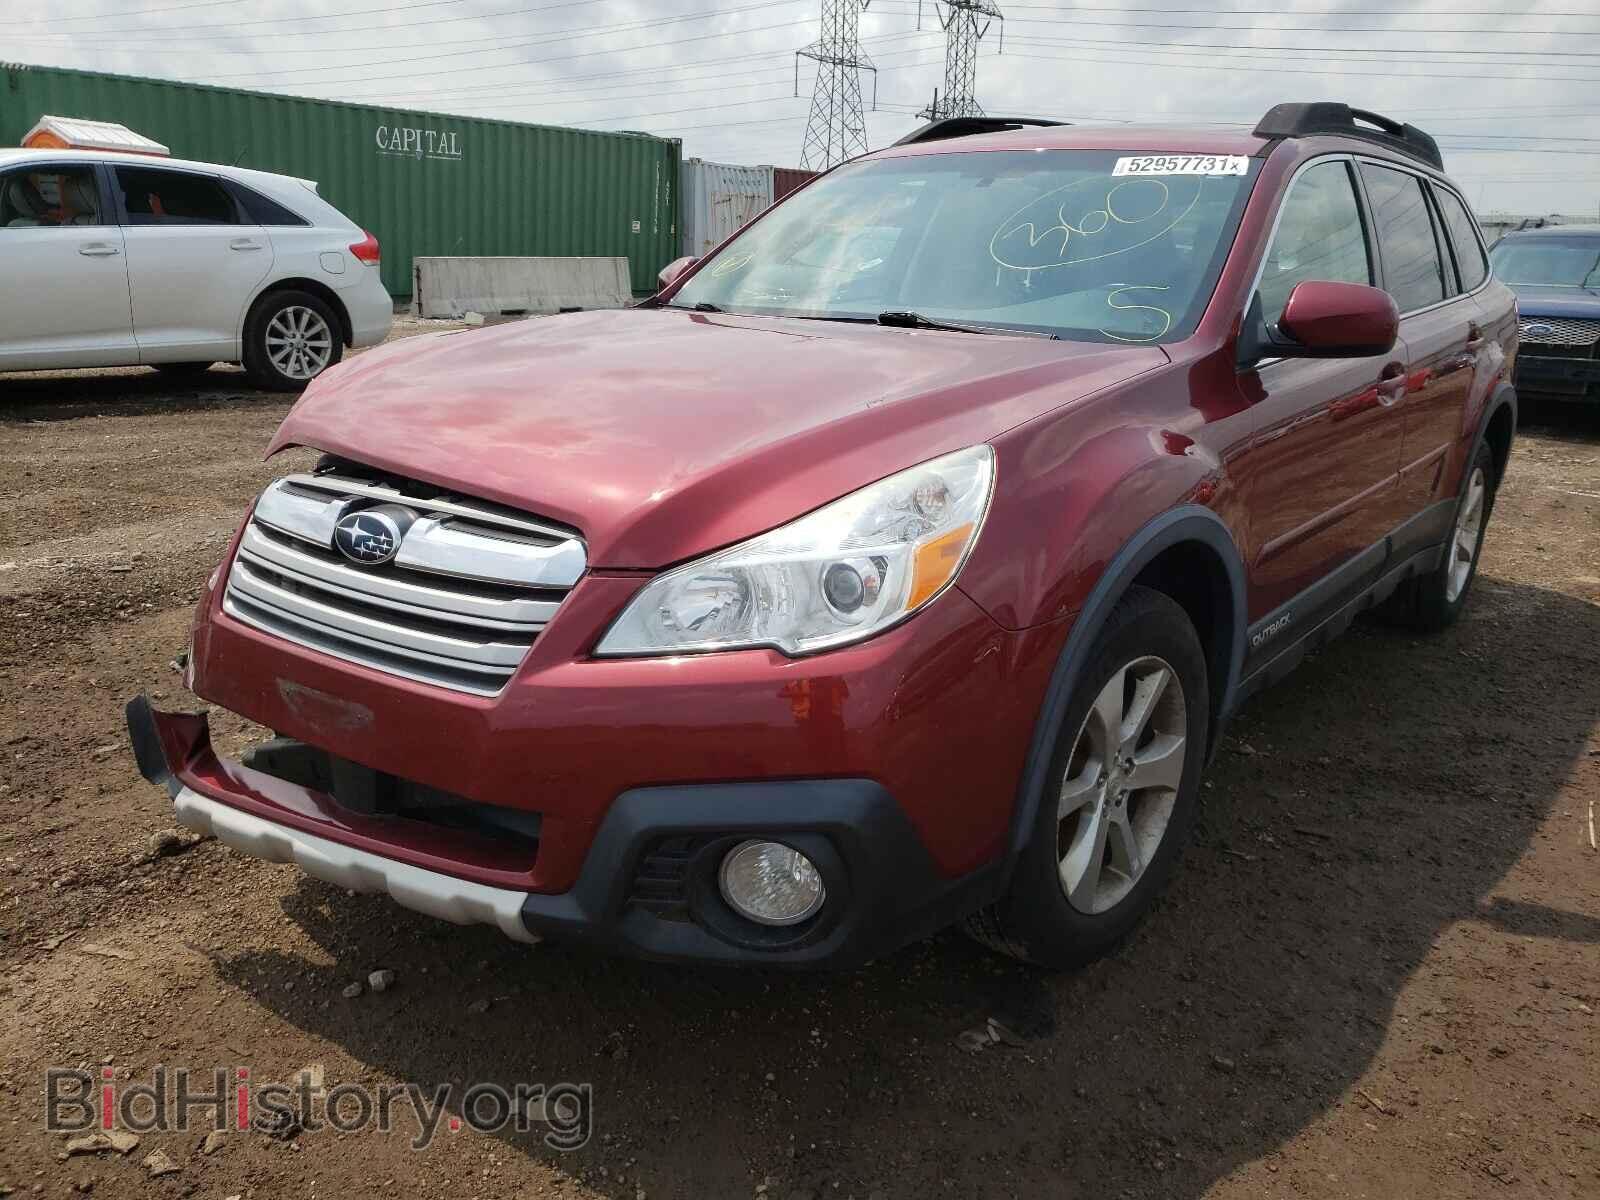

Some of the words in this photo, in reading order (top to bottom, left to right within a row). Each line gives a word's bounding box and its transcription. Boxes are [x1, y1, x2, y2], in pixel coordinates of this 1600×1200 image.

[375, 126, 462, 154] CAPITAL
[1002, 179, 1168, 256] 360
[1252, 611, 1292, 647] OUTBACK
